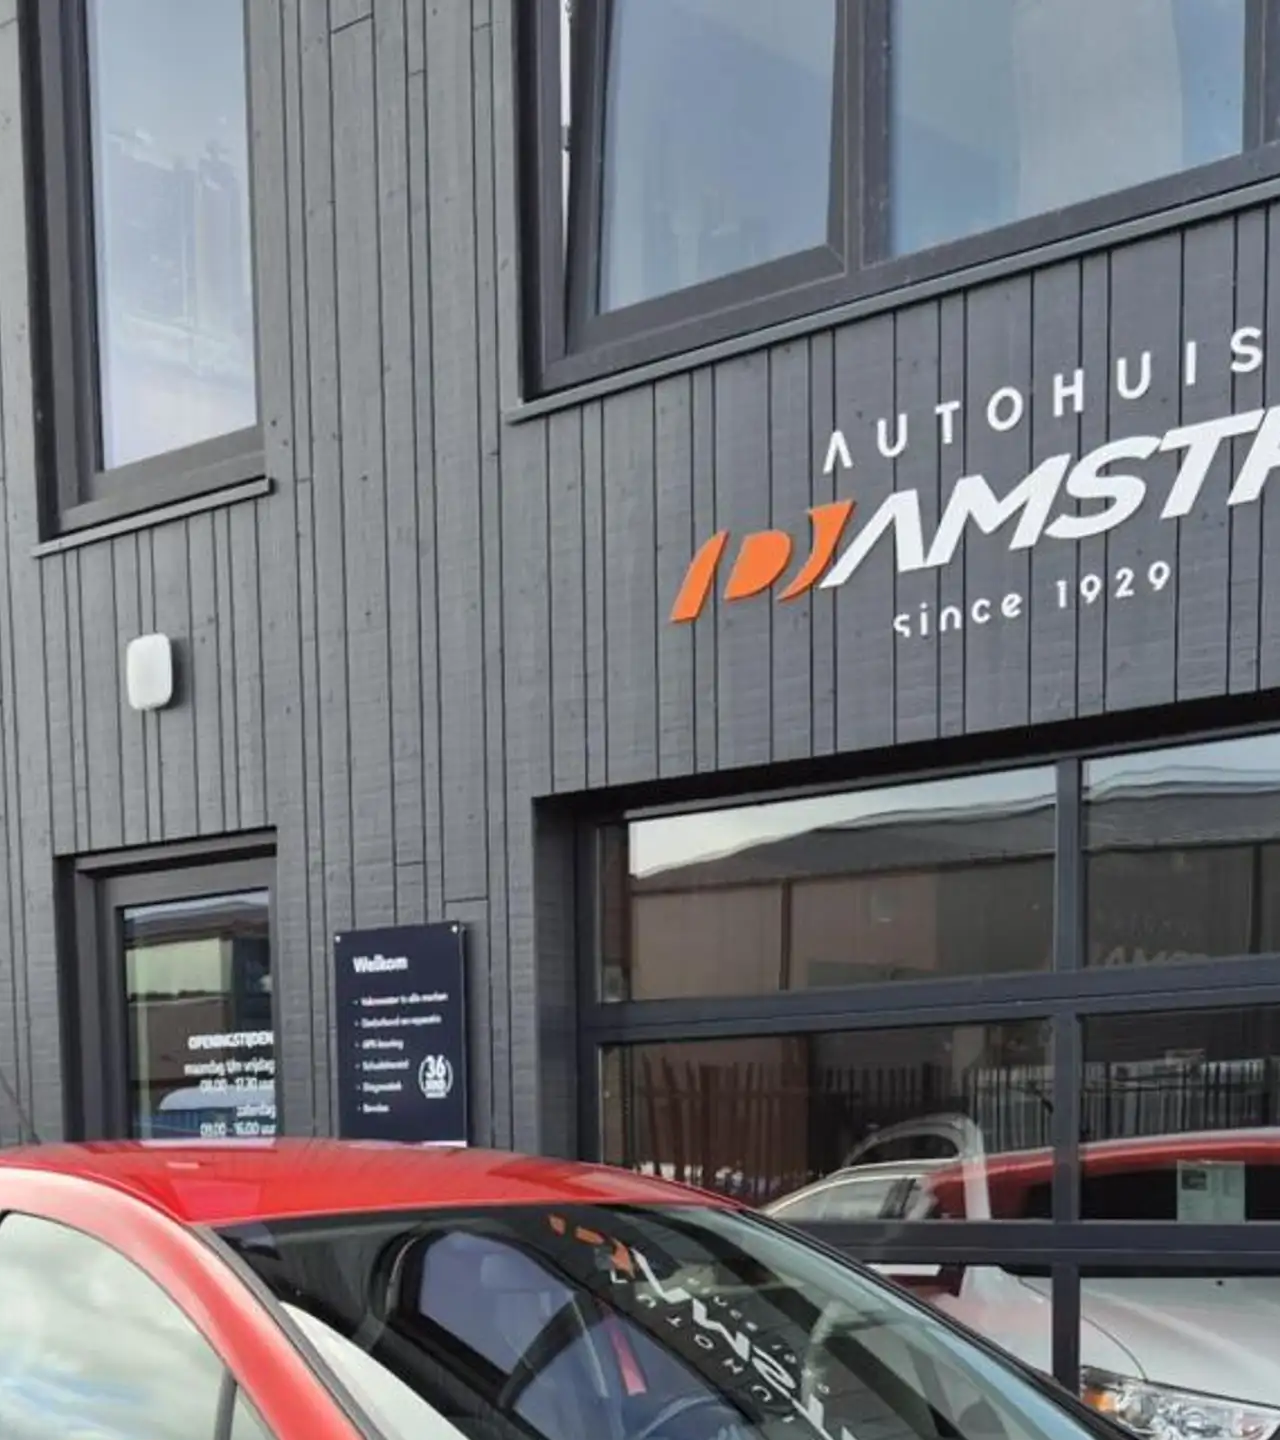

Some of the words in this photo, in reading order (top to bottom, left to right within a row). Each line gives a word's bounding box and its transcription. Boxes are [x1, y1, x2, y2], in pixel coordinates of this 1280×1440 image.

[823, 326, 1263, 474] AUTOHUIS
[893, 593, 1022, 638] since
[1057, 560, 1170, 608] 1929
[352, 953, 409, 973] Welkom
[424, 1054, 447, 1078] 36
